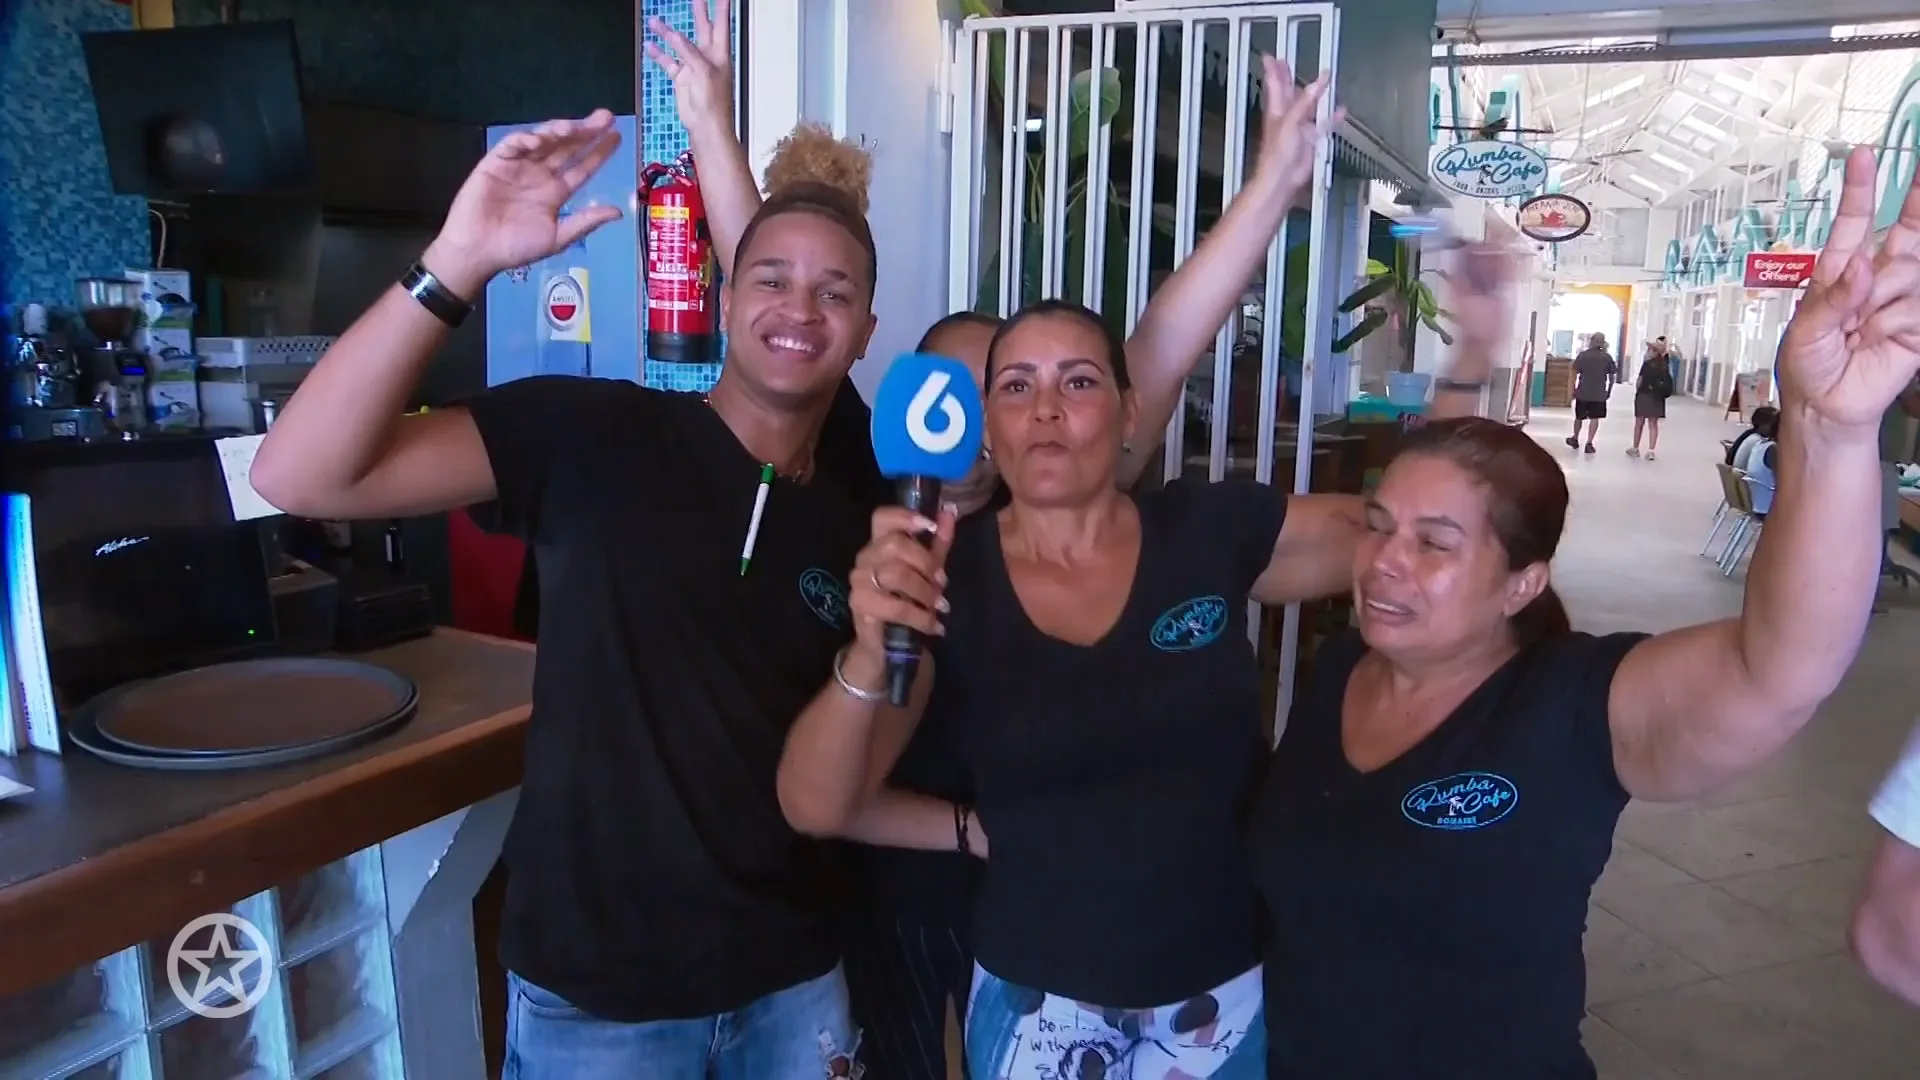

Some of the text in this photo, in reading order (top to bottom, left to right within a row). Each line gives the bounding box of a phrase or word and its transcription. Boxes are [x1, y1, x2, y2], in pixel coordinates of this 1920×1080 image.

[1437, 146, 1527, 177] Rumba
[1491, 162, 1543, 184] Cafe
[1754, 259, 1808, 273] Enjoy our
[905, 369, 966, 454] 6
[1407, 778, 1494, 814] Rumba
[1462, 788, 1511, 814] Cafe
